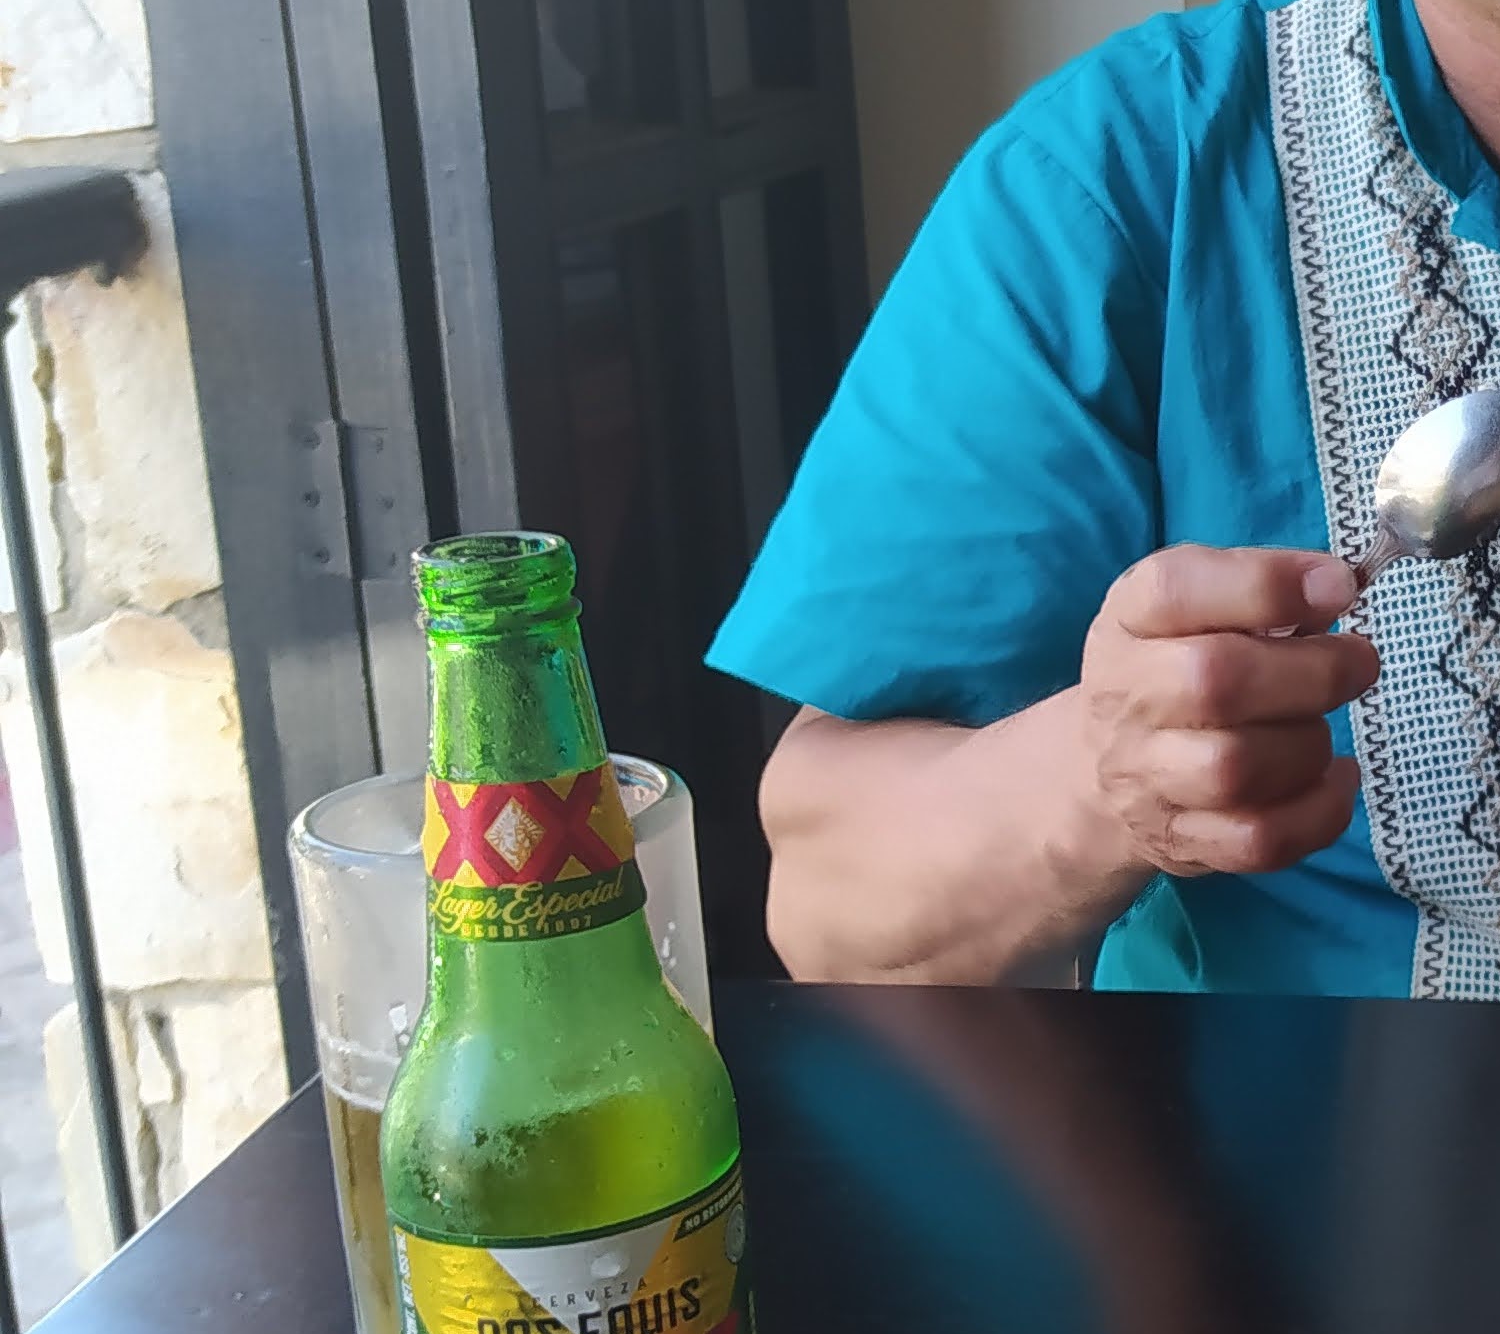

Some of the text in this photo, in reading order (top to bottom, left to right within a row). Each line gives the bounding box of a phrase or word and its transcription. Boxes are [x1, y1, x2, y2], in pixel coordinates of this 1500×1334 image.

[428, 868, 625, 934] Lager Especial
[532, 1277, 648, 1309] CERVEZA
